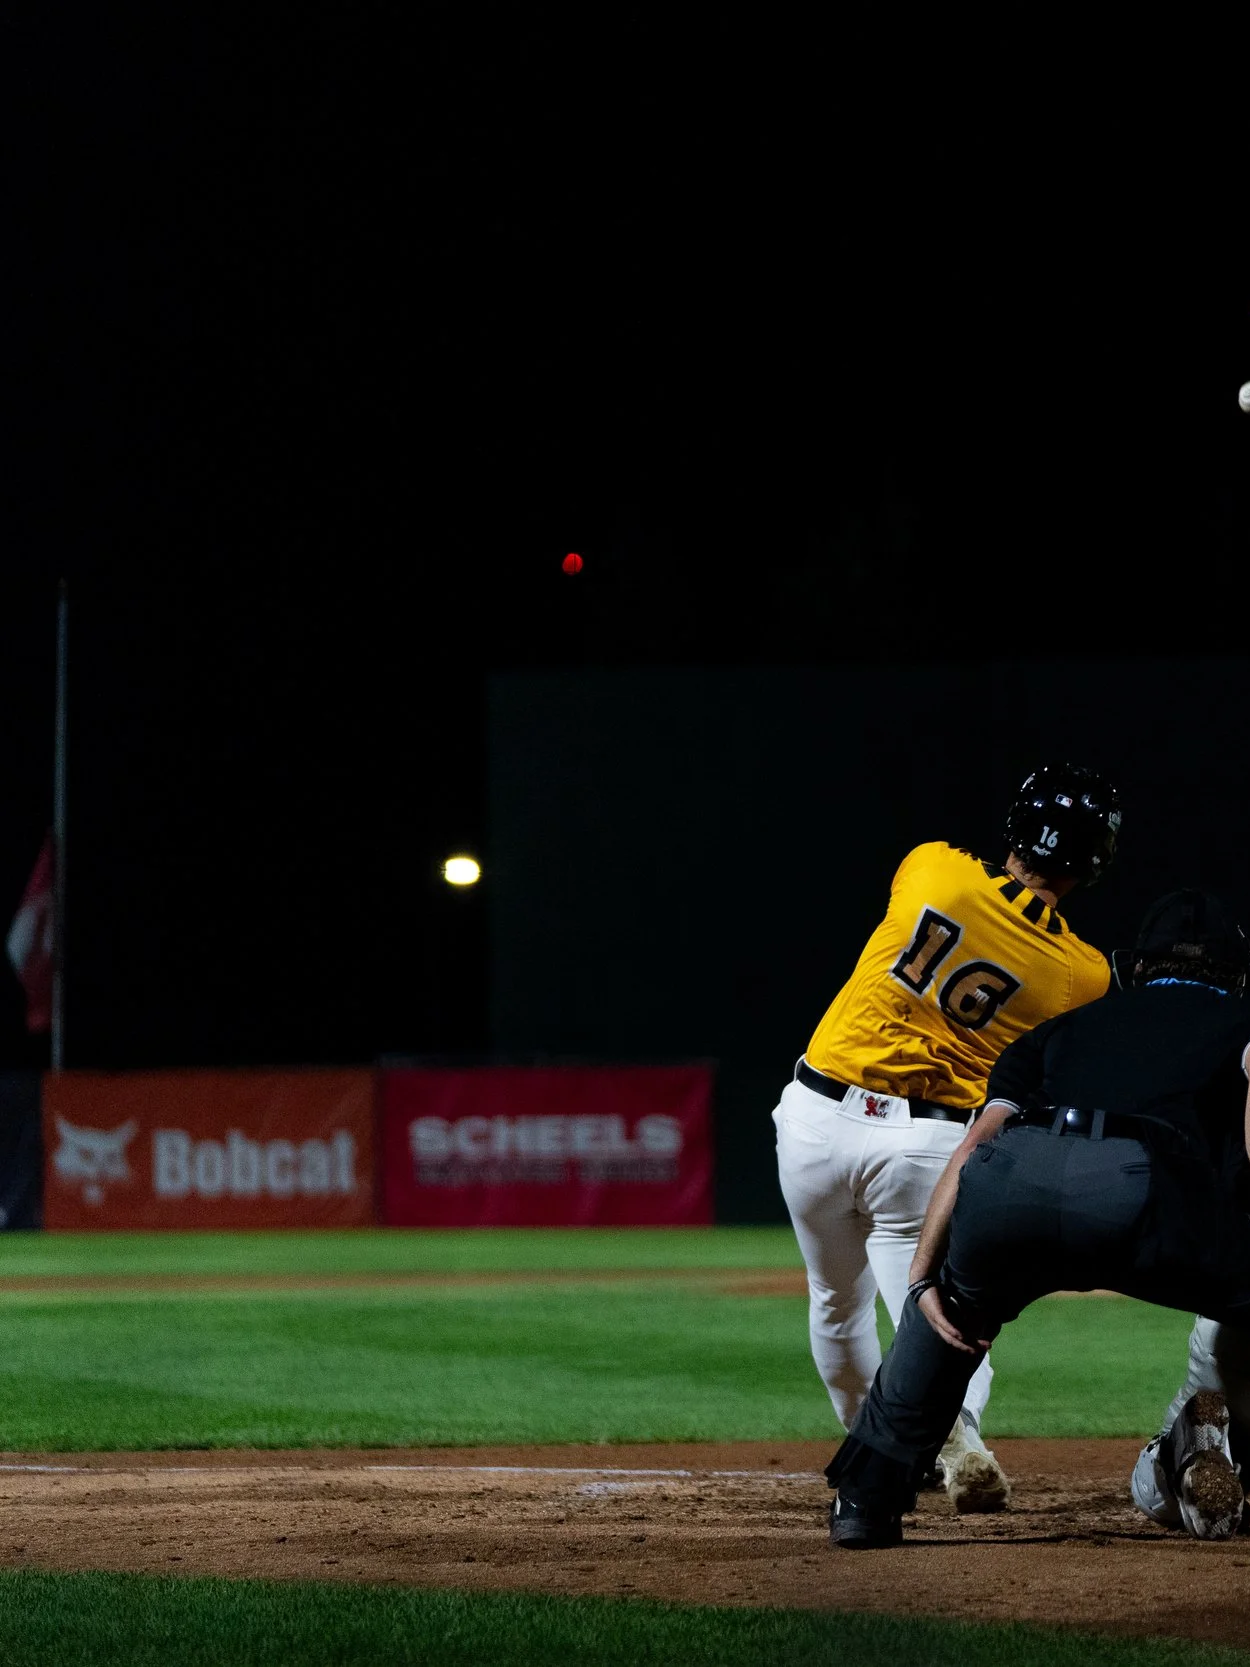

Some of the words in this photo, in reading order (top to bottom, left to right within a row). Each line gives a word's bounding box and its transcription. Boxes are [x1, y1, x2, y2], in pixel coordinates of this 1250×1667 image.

[1040, 825, 1059, 848] 16
[889, 904, 1023, 1031] 16
[153, 1127, 357, 1198] Bobcat
[408, 1114, 684, 1160] SCHEELS
